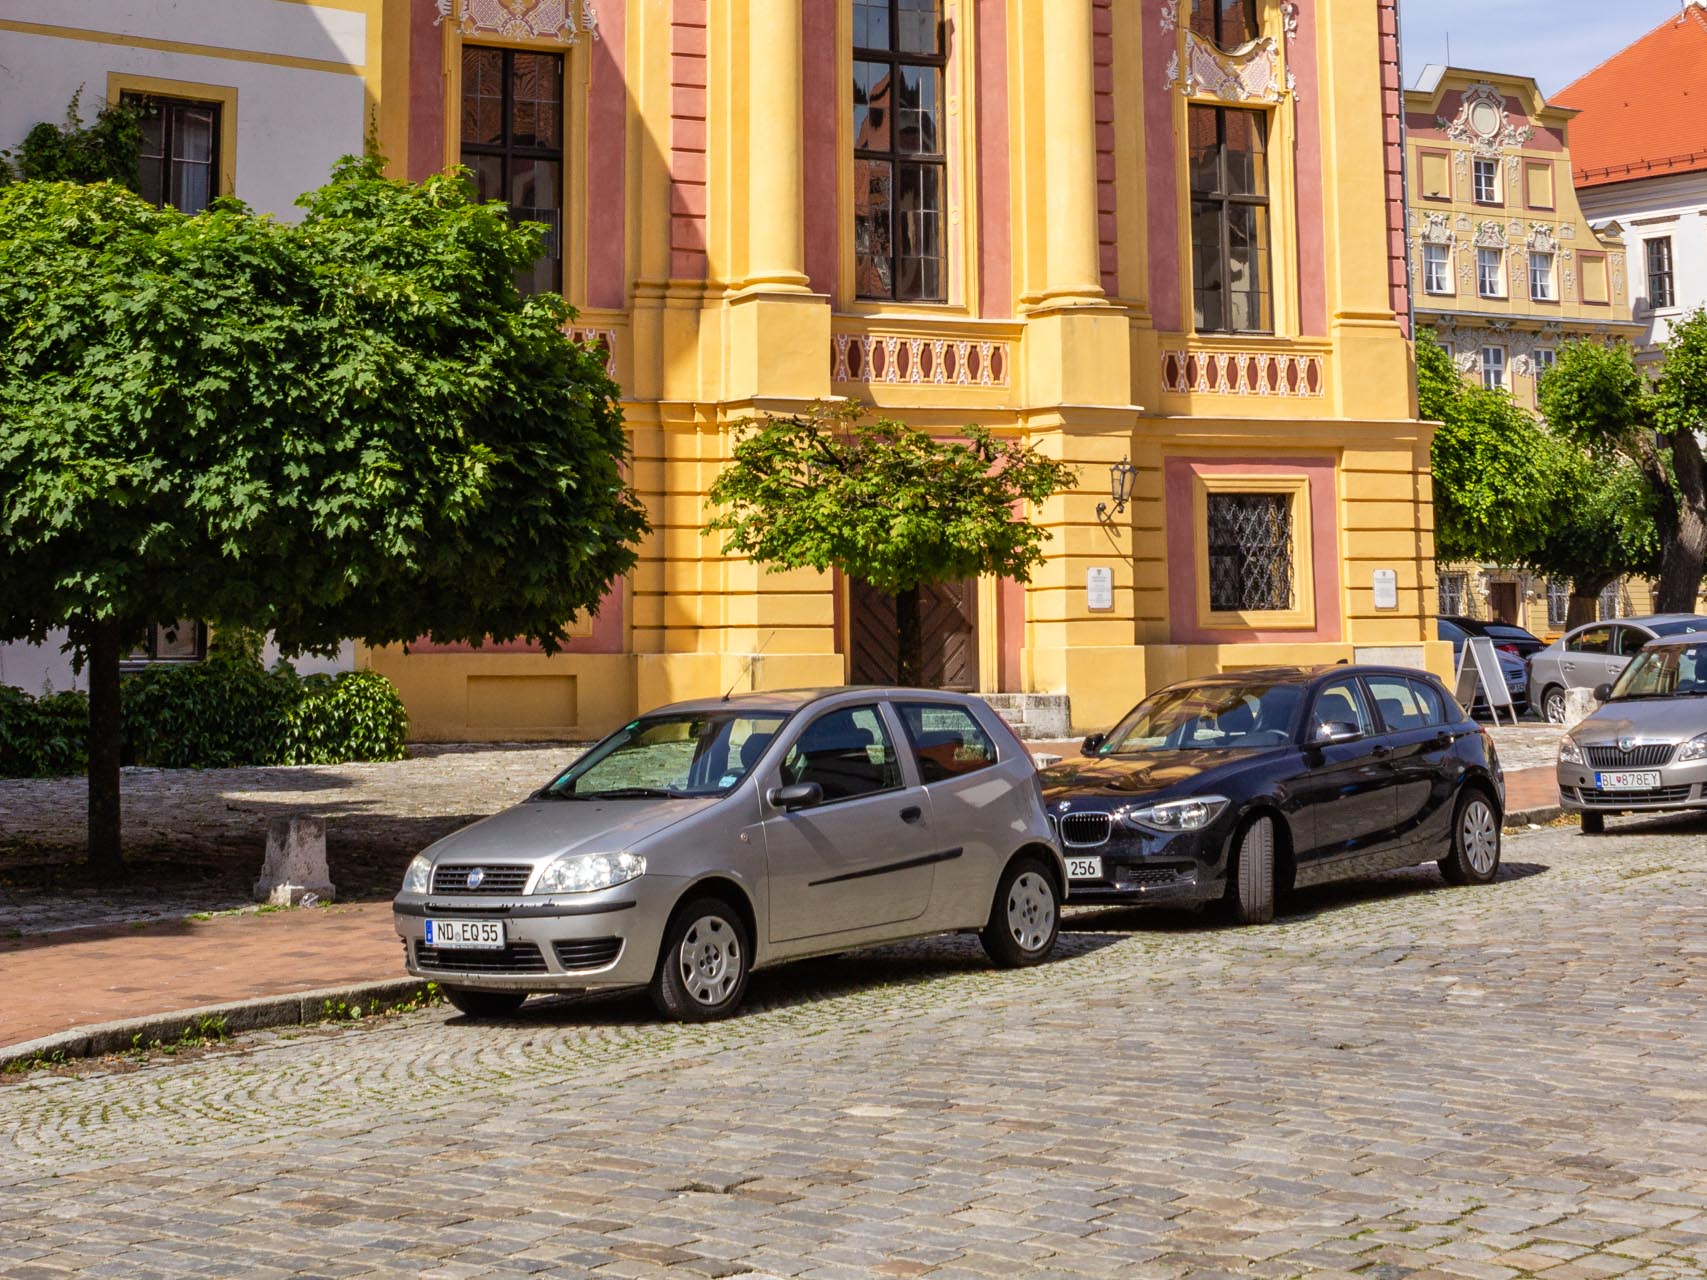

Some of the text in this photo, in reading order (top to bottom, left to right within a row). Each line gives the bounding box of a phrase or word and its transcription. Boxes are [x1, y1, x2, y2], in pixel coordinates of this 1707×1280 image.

[1602, 774, 1616, 786] BL
[1070, 861, 1096, 876] 256
[437, 923, 454, 941] ND
